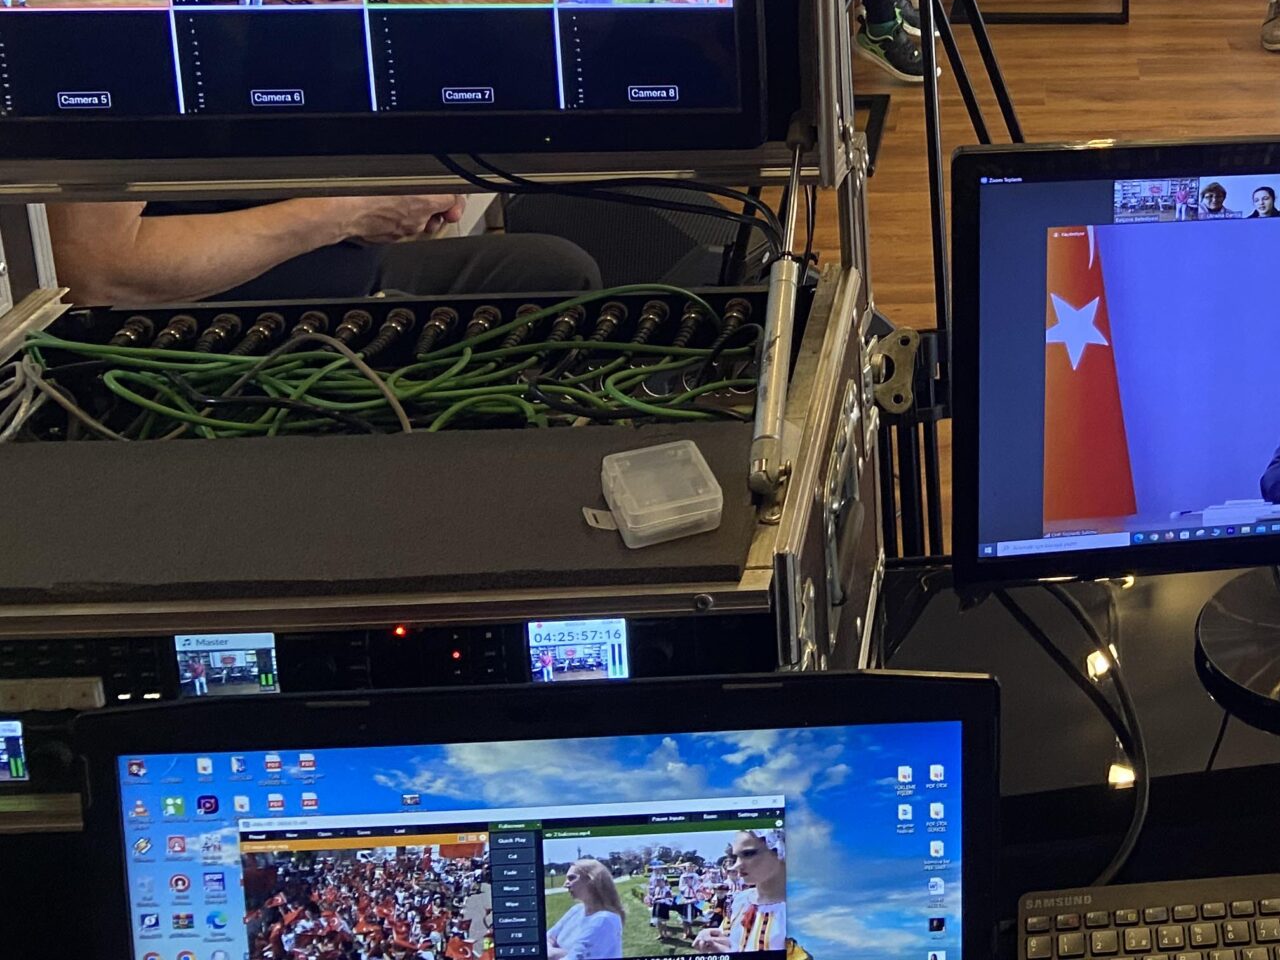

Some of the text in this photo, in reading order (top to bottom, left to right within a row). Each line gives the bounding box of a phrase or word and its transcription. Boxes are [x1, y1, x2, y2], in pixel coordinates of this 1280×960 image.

[446, 91, 490, 99] Camera 7
[632, 88, 675, 97] Camera 8
[61, 95, 107, 104] Camera 5
[254, 93, 300, 102] Camera 6
[534, 629, 622, 643] 04:25:57:16
[196, 638, 229, 646] Master
[1025, 895, 1092, 909] SAMSUNG
